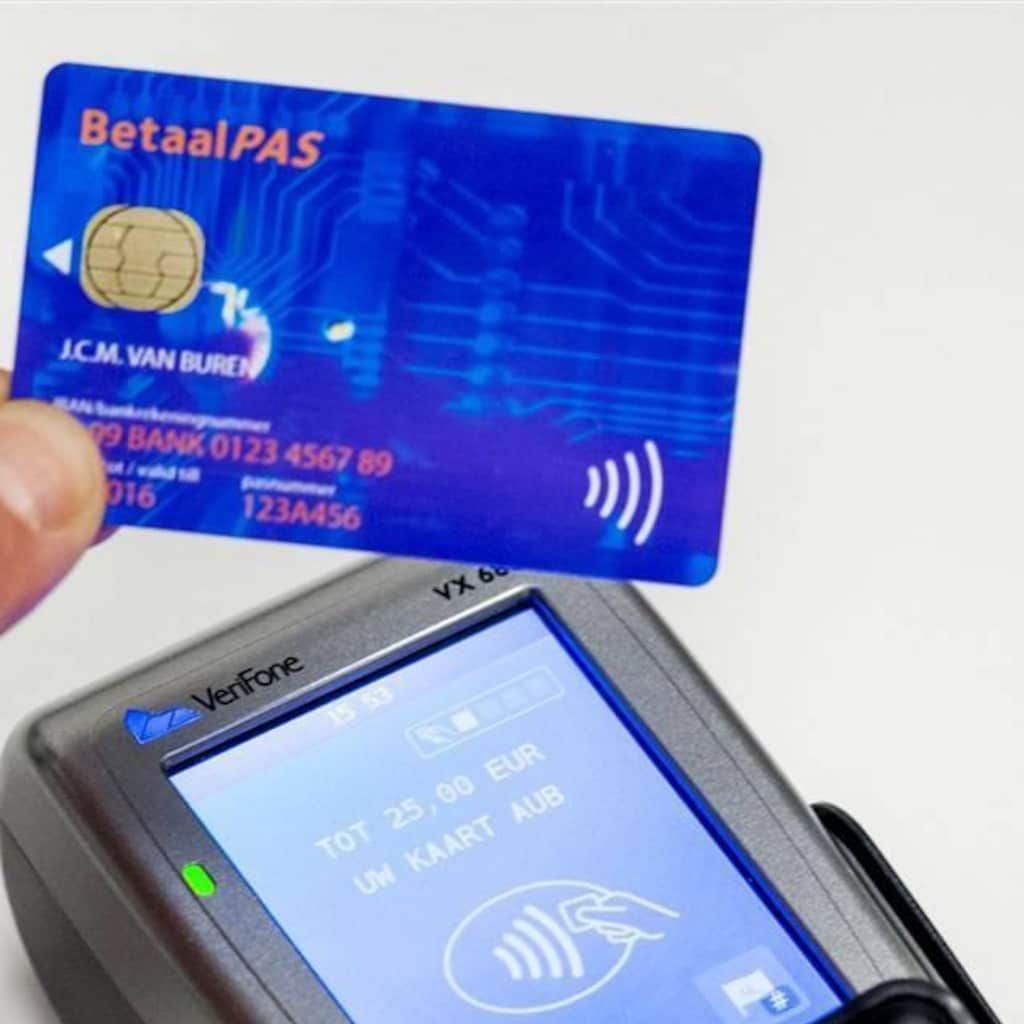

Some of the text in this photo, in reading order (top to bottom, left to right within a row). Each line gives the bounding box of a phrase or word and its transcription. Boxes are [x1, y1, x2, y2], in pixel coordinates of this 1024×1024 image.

[79, 107, 325, 169] BetaalPAS
[60, 338, 124, 365] J.C.M.
[126, 345, 177, 371] VAN
[127, 424, 204, 457] BANK
[210, 433, 277, 466] 0123
[284, 442, 354, 471] 4567
[357, 448, 393, 477] 89
[244, 493, 362, 531] 123A456
[432, 574, 475, 600] VX
[191, 654, 306, 713] VeriFone
[316, 821, 369, 860] TOT
[485, 742, 547, 784] EUR
[403, 815, 499, 873] KAART
[512, 784, 567, 824] AUB
